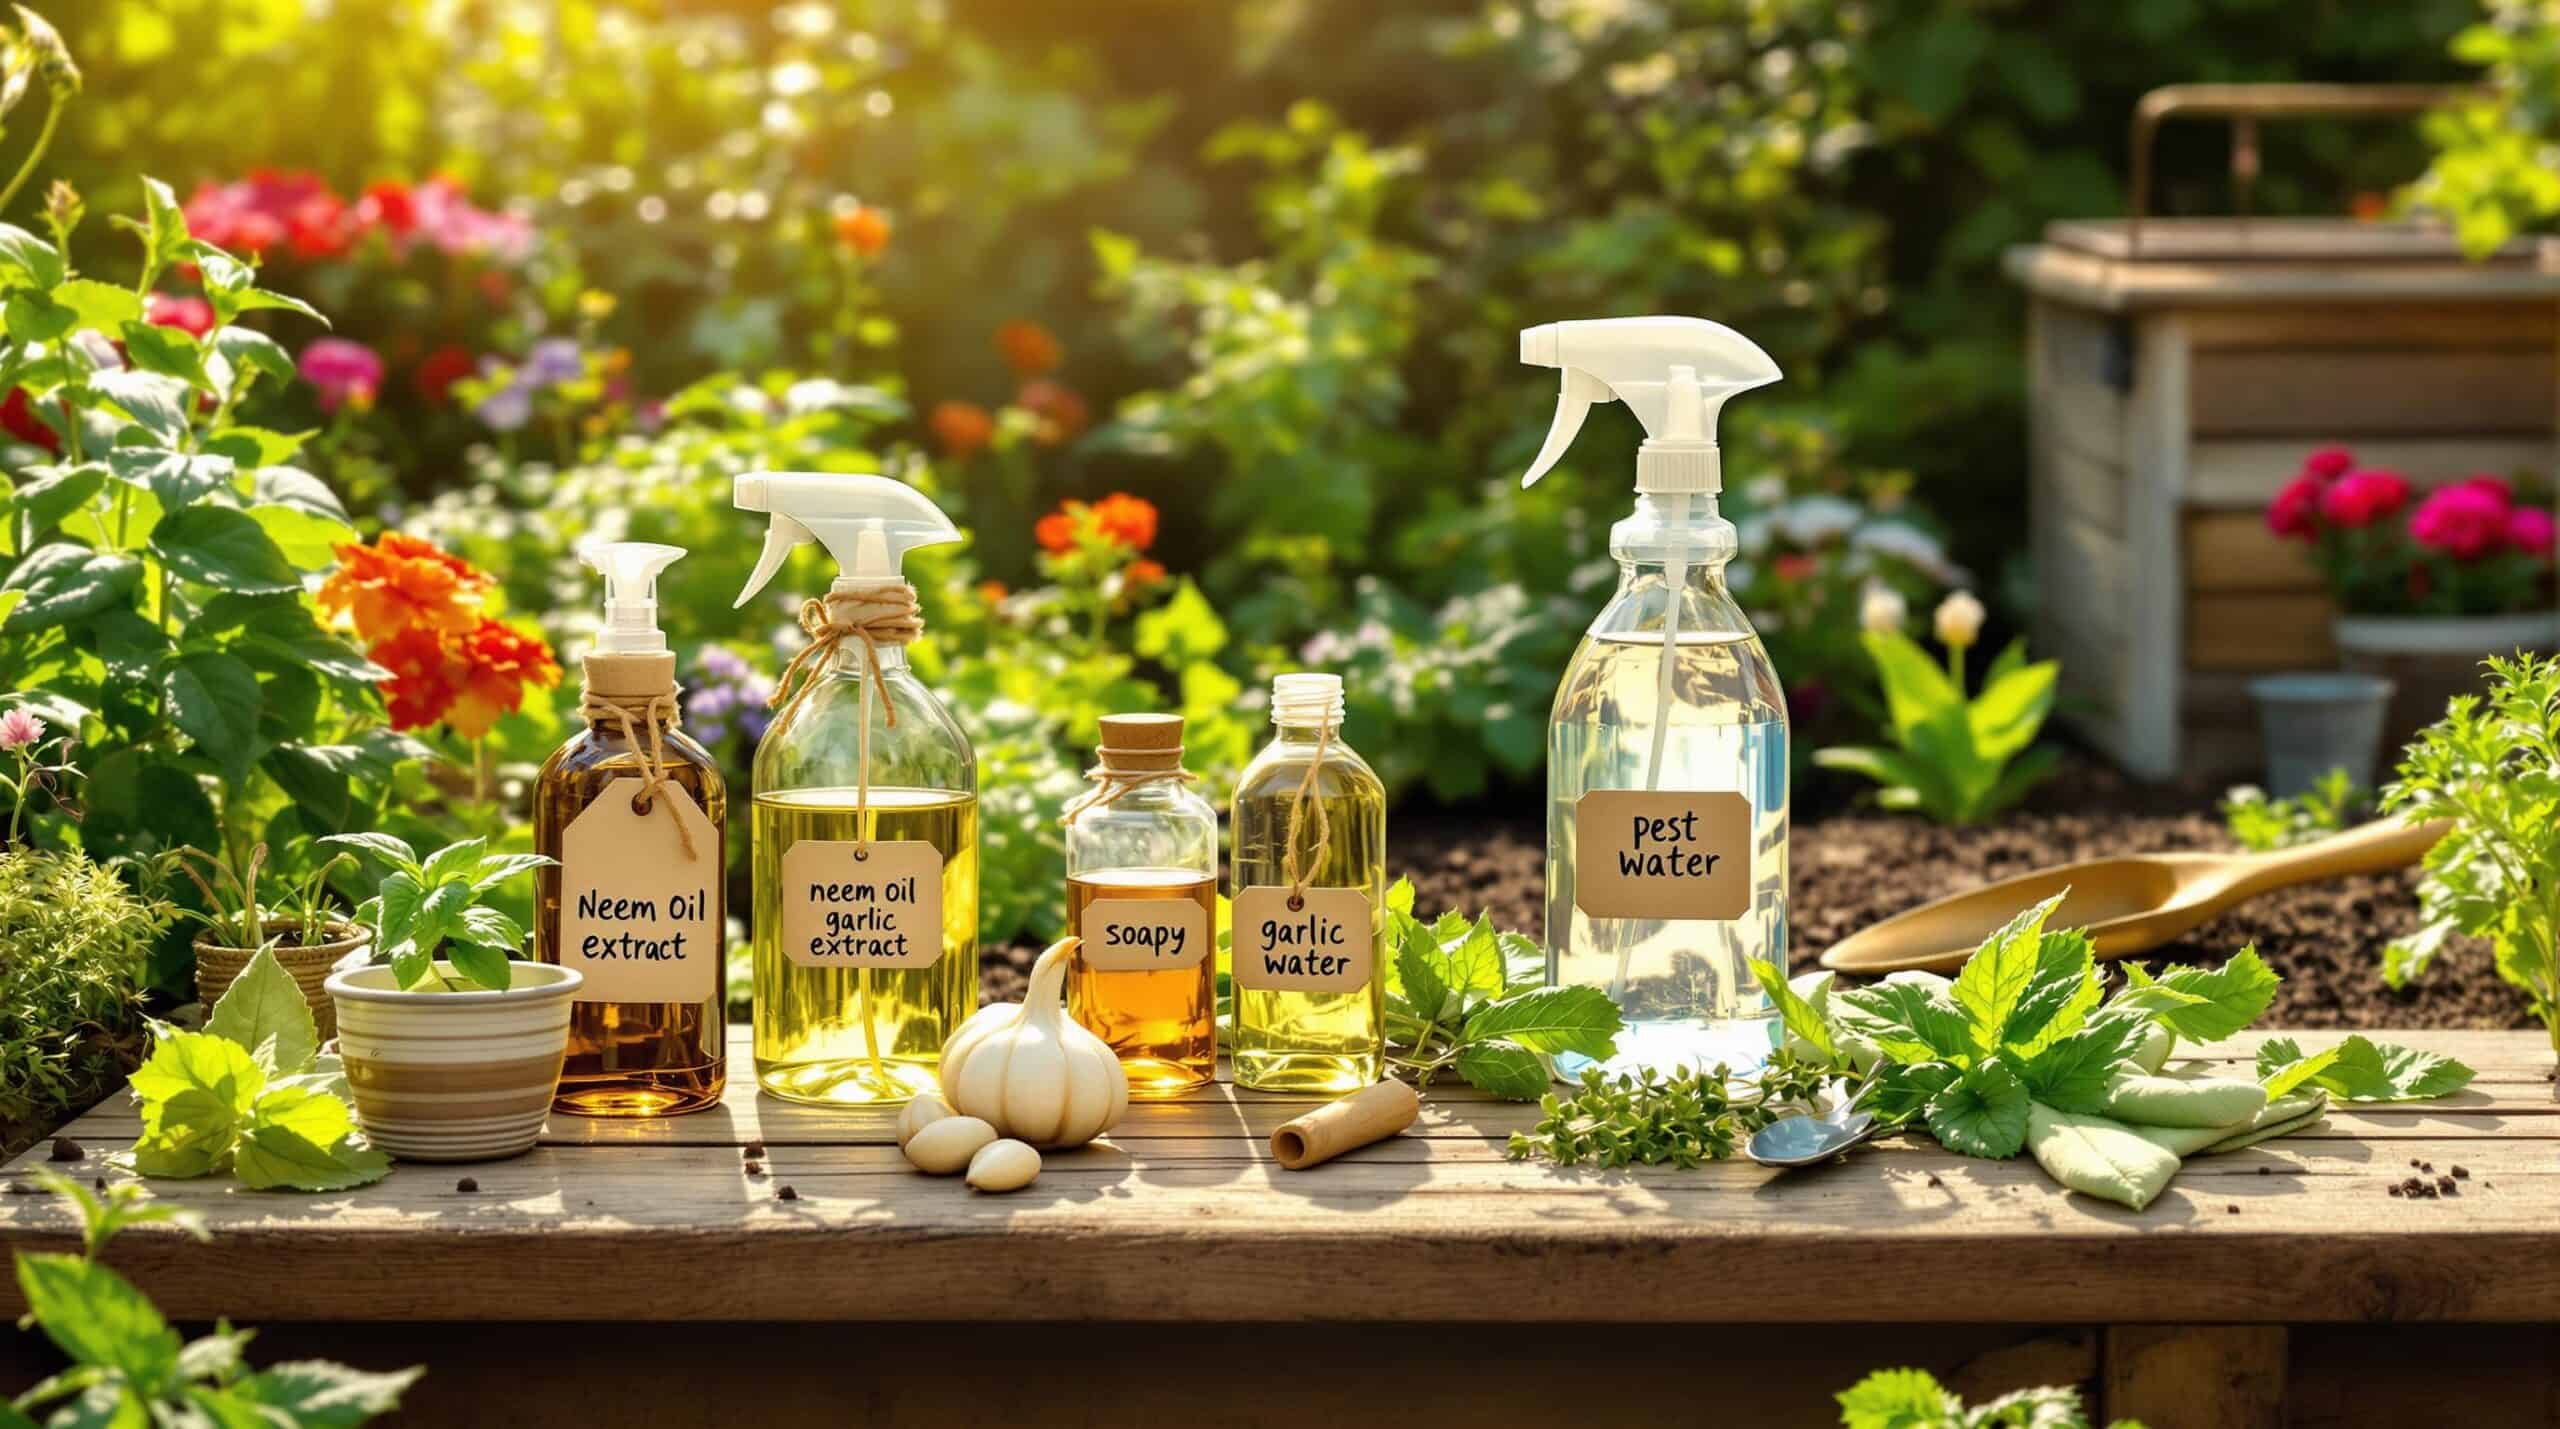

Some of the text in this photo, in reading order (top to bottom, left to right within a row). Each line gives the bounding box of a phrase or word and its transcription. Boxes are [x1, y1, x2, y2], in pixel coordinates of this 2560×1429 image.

[1633, 810, 1699, 851] pest
[1618, 845, 1721, 877] water
[578, 888, 705, 922] Neem Oil
[810, 877, 915, 904] neem oil
[825, 906, 897, 938] garlic
[1261, 913, 1345, 952] garlic
[582, 931, 687, 961] extract
[810, 933, 908, 957] extract
[1105, 924, 1185, 957] soapy
[1264, 948, 1351, 976] water
